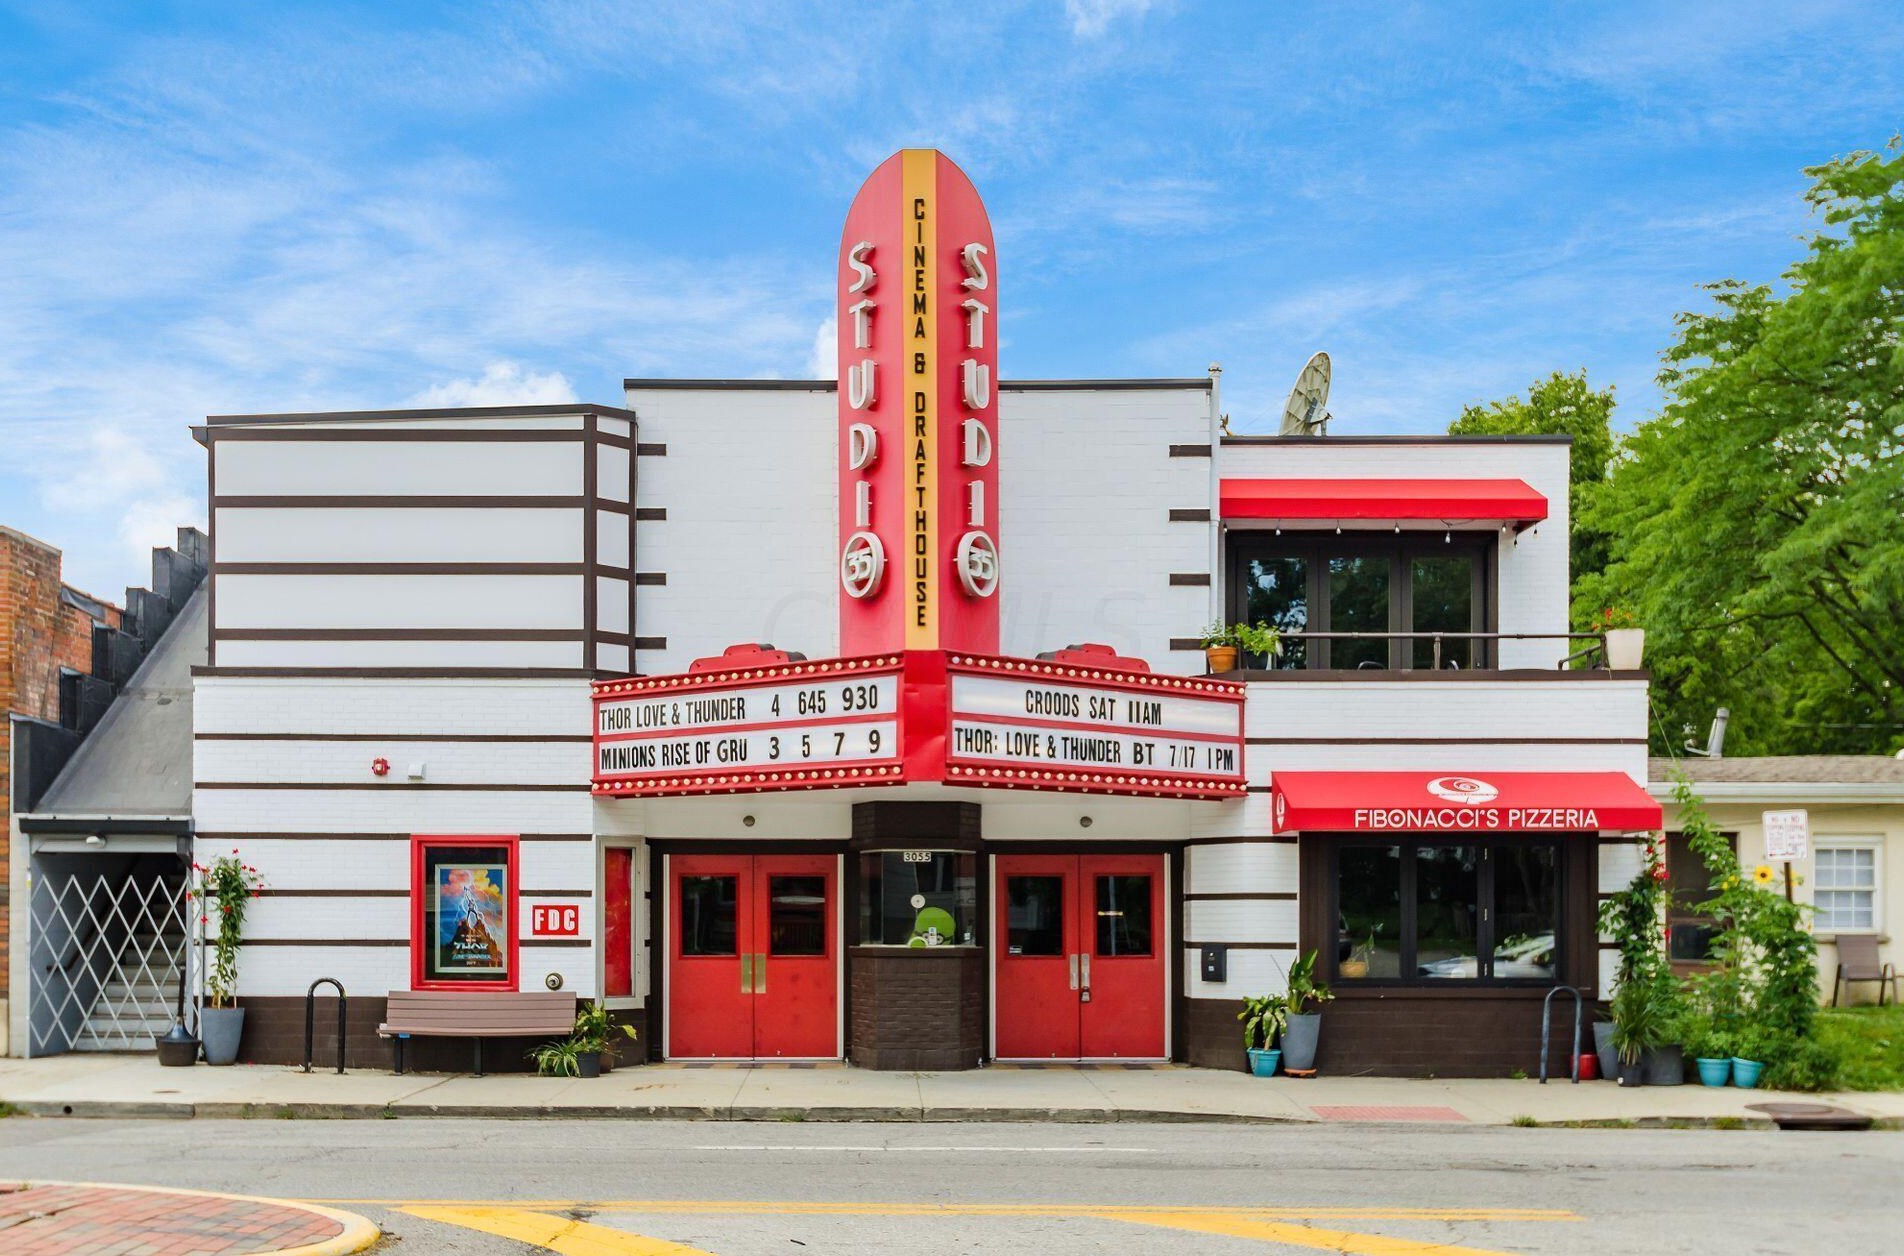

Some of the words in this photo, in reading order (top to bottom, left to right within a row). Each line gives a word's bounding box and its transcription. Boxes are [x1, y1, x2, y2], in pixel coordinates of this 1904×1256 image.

[914, 198, 926, 338] CINEMA
[914, 353, 926, 374] &
[914, 391, 927, 627] DRAFTHOUSE
[847, 547, 872, 581] 35
[968, 546, 994, 580] 35
[600, 707, 631, 731] THOR
[636, 704, 667, 728] LOVE
[671, 702, 681, 725] &
[685, 697, 746, 724] THUNDER
[771, 694, 780, 717] 4
[798, 690, 826, 714] 645
[842, 684, 878, 711] 930
[1025, 689, 1079, 718] CROODS
[1089, 695, 1116, 721] SAT
[601, 745, 656, 770] MINIONS
[662, 742, 690, 766] RISE
[695, 741, 711, 764] OF
[717, 738, 748, 763] GRU
[768, 736, 780, 760] 3
[802, 734, 811, 758] 5
[834, 732, 845, 756] 7
[869, 729, 881, 754] 9
[955, 727, 998, 754] THOR:
[1006, 731, 1040, 757] LOVE
[1047, 735, 1056, 759] &
[1061, 736, 1121, 763] THUNDER
[1133, 742, 1155, 766] BT
[1169, 744, 1196, 769] 7/17
[1354, 808, 1499, 829] FIBONACCI'S
[1508, 808, 1599, 829] PIZZERIA
[905, 852, 931, 861] 3055
[534, 908, 576, 931] FDC
